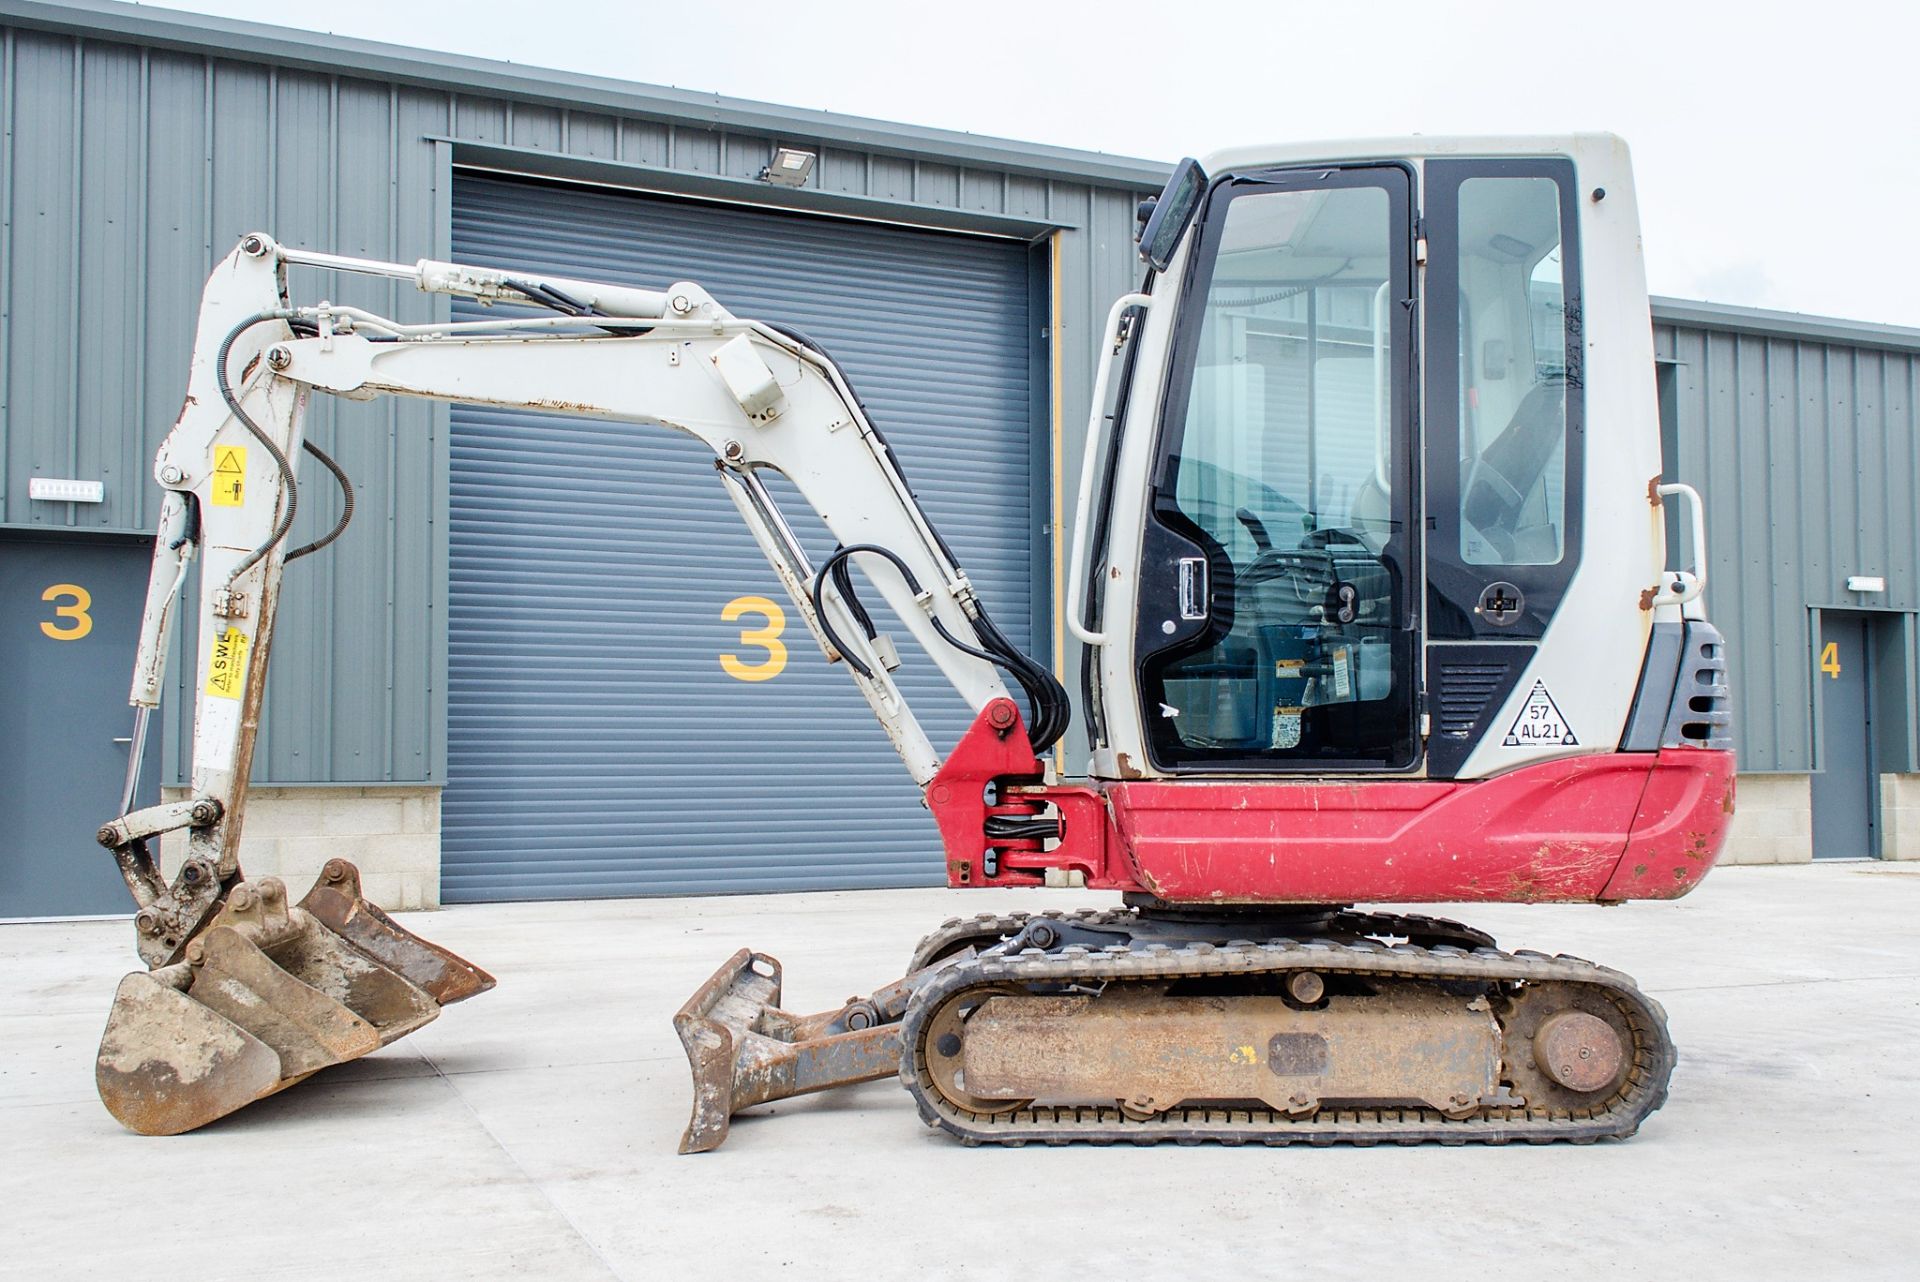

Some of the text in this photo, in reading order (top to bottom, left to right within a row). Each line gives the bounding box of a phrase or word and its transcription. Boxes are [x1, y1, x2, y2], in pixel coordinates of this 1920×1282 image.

[40, 583, 93, 640] 3
[719, 596, 788, 681] 3
[1820, 642, 1841, 679] 4
[1530, 705, 1549, 720] 57
